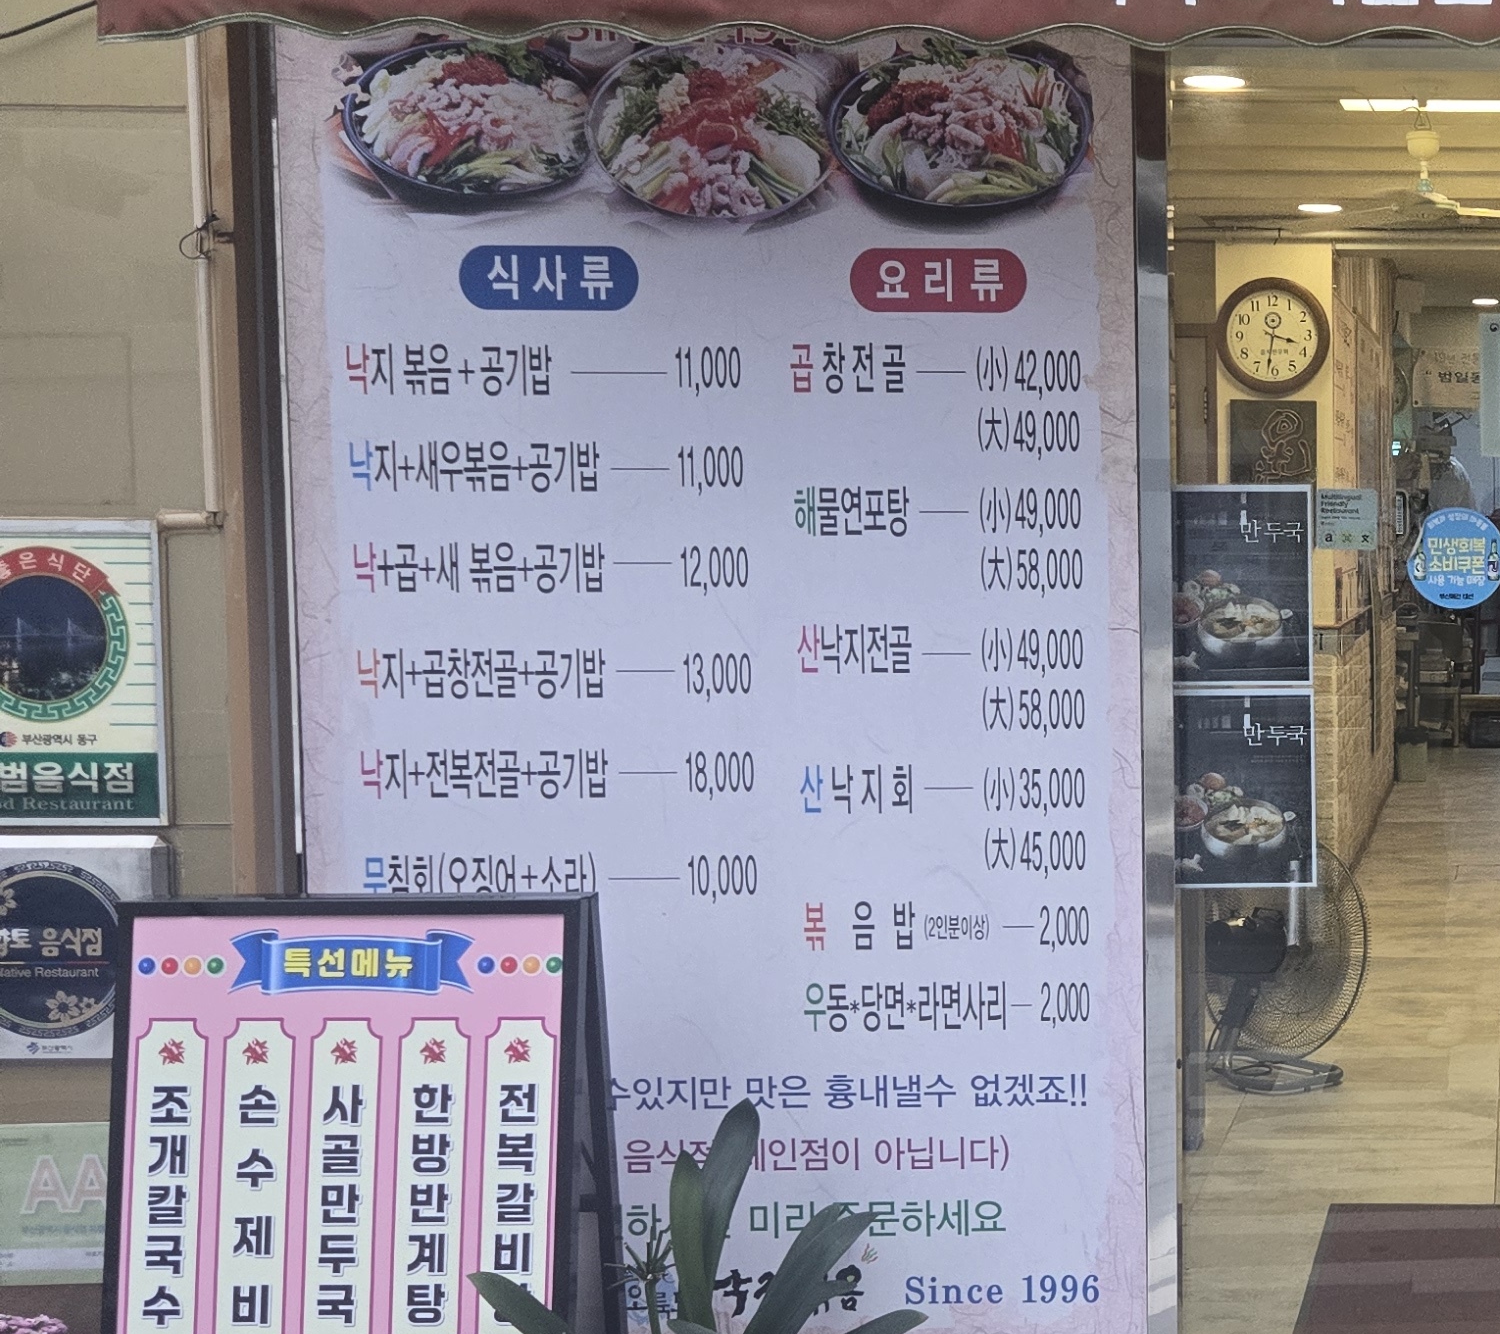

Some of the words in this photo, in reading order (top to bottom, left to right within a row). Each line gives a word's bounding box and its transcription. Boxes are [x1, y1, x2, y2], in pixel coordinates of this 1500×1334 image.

[487, 255, 613, 301] 식사류
[876, 258, 1004, 302] 요리류
[346, 343, 394, 395] 낙지
[404, 343, 451, 395] 볶음
[481, 344, 551, 396] 공기밥
[676, 346, 741, 396] 11,000
[349, 440, 599, 492] 낙지+새우볶음+공기밥
[677, 445, 743, 495] 11,000
[794, 486, 909, 537] 해물연포탕
[1240, 519, 1304, 543] 만두국
[1428, 537, 1486, 555] 민생회복
[1429, 556, 1485, 575] 소비쿠폰
[680, 546, 748, 596] 12,000
[797, 624, 912, 674] 산낙지전골
[357, 648, 605, 699] 낙지+곱창전골+공기밥
[683, 652, 751, 702] 13,000
[22, 734, 72, 746] 부산광역시
[77, 734, 97, 746] 동구
[1243, 723, 1307, 746] 만두국
[360, 748, 608, 799] 낙지+전복전골+공기밥
[686, 751, 754, 801] 18,000
[22, 797, 134, 811] Restaurant
[687, 854, 758, 903] 10,000
[39, 928, 102, 956] 음식점
[924, 914, 990, 941] (2인분이상)
[1040, 905, 1089, 953] 2,000
[35, 967, 99, 977] Restaurant
[283, 948, 415, 978] 특선메뉴
[1041, 982, 1090, 1028] 2,000
[746, 1075, 811, 1109] 맛은
[824, 1074, 956, 1110] 흉내낼수
[971, 1073, 1087, 1107] 없겠죠!!
[875, 1134, 1009, 1171] 아닙니다)
[142, 1085, 191, 1326] 조개칼국수
[231, 1084, 279, 1326] 손수제비
[315, 1084, 364, 1324] 사골만두국
[406, 1084, 453, 1325] 한방반계탕
[492, 1083, 538, 1324] 전복갈비
[905, 1276, 1003, 1304] Since
[1022, 1274, 1099, 1303] 1996
